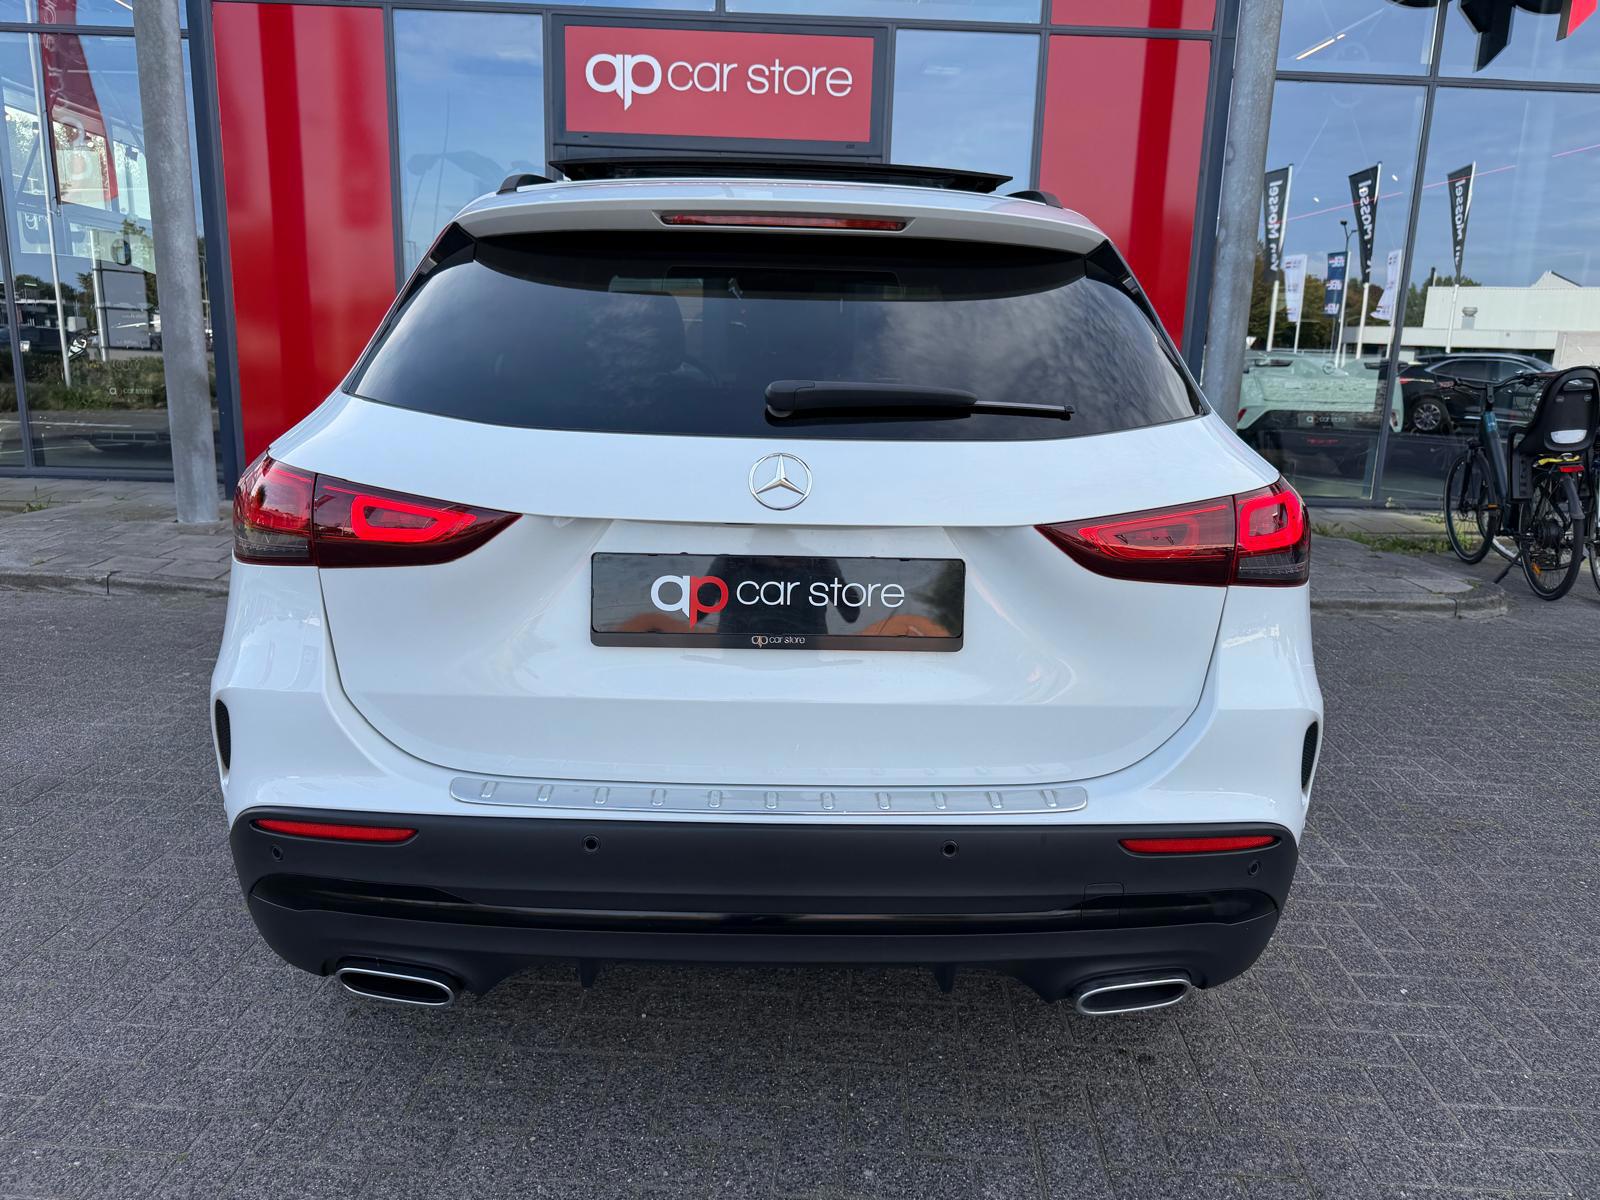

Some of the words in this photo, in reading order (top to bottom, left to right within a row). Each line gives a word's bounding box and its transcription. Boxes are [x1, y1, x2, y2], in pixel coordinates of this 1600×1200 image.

[585, 53, 662, 111] ap
[667, 61, 738, 92] car
[746, 59, 853, 97] store
[650, 575, 729, 630] ap
[736, 580, 801, 606] car
[808, 577, 905, 608] store
[751, 635, 768, 648] ap
[769, 636, 784, 644] car
[784, 635, 806, 644] store
